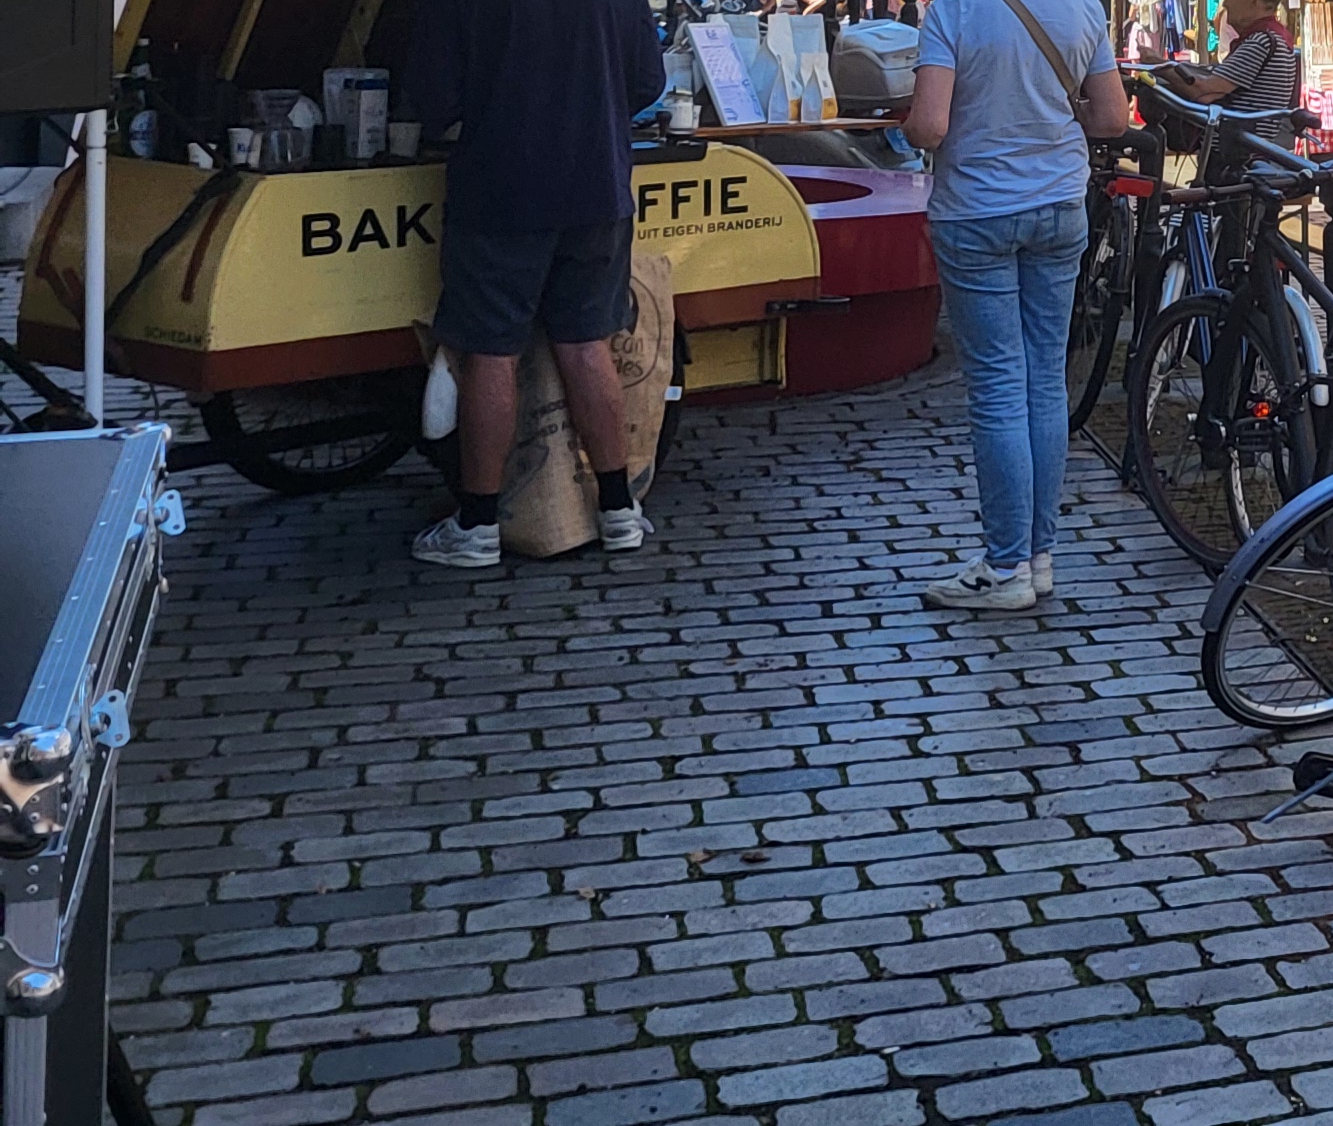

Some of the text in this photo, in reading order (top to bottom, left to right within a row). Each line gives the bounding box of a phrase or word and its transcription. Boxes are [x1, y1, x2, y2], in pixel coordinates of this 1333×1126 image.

[301, 175, 749, 258] BAK FFIE
[637, 215, 783, 240] UIT EIGEN BRANDERIJ
